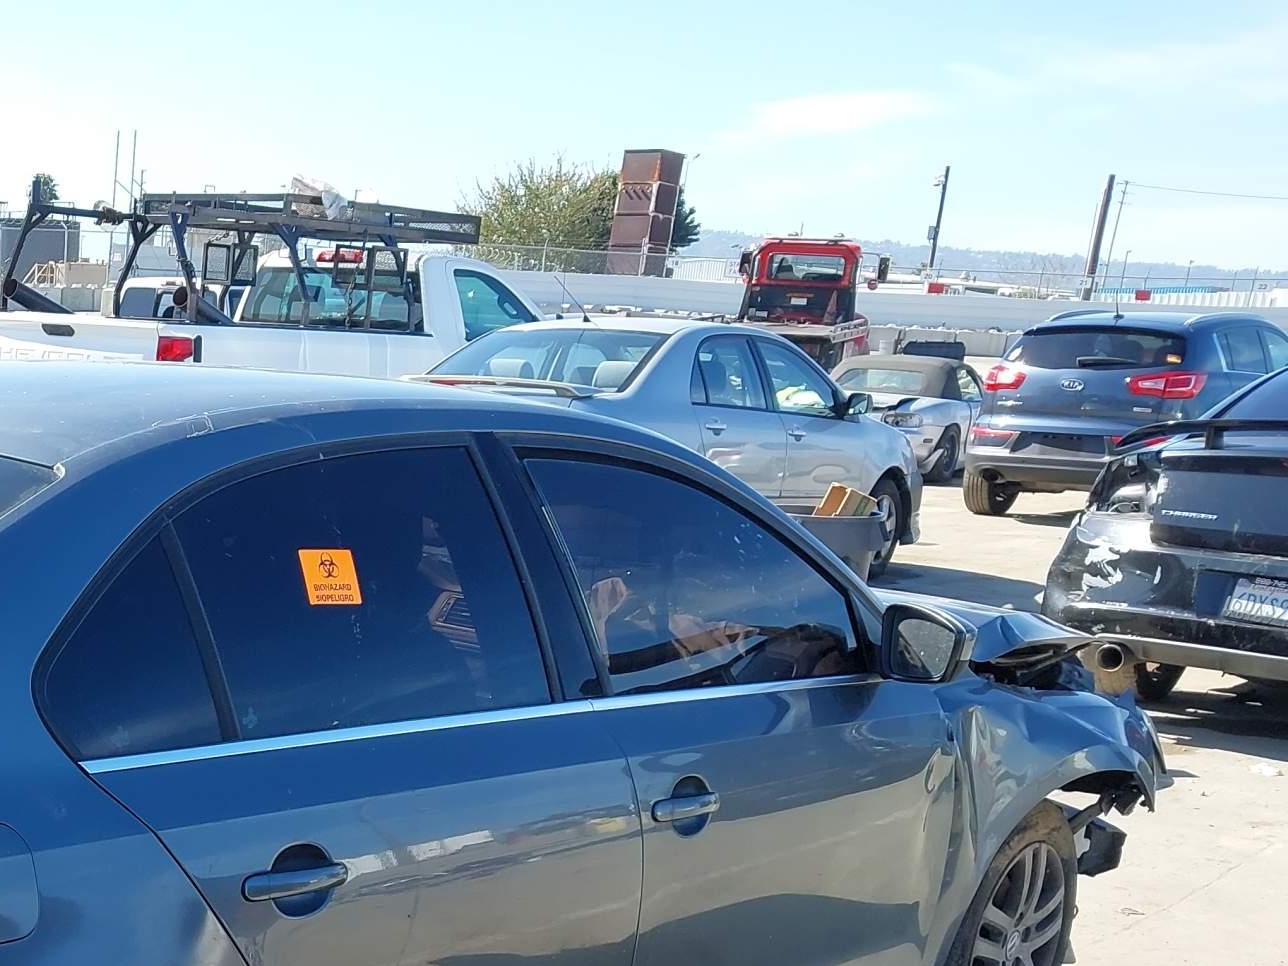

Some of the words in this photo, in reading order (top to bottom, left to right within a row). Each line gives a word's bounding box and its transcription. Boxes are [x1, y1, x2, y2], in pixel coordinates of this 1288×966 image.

[1161, 509, 1218, 521] CHARGER
[313, 583, 352, 592] BIOHAZARD
[315, 593, 354, 602] BIOPELIGRO
